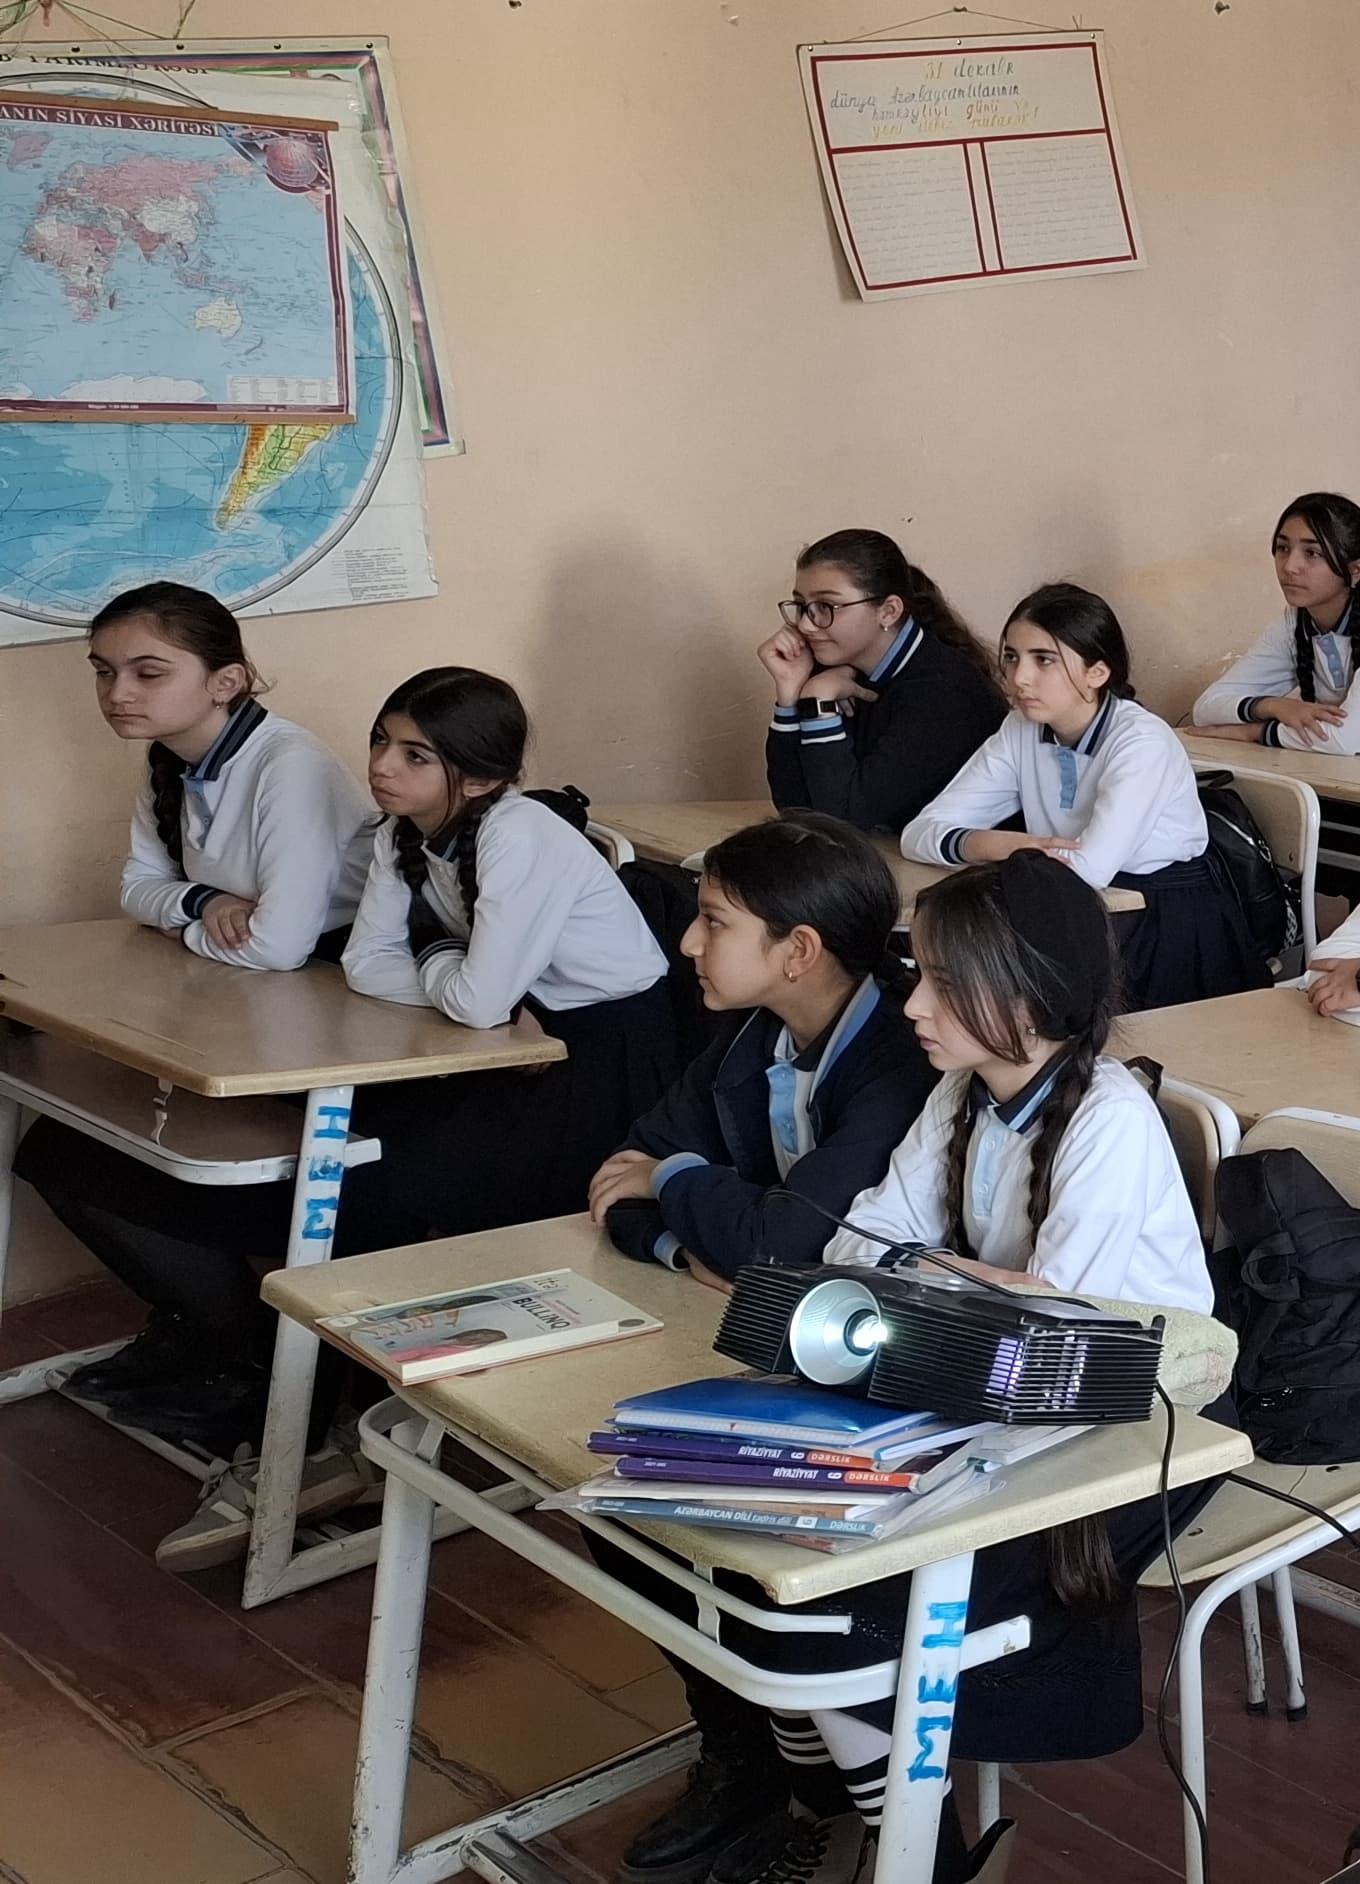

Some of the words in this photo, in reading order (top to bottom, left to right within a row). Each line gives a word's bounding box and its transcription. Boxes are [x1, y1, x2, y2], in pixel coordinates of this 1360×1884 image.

[55, 108, 122, 128] SİYASİ
[129, 116, 219, 136] XƏRİTƏSİ
[302, 1105, 350, 1240] MEH
[737, 1446, 783, 1459] RİYAZİYYAT
[773, 1467, 819, 1480] RİYAZİYYAT
[908, 1600, 970, 1784] MEH
